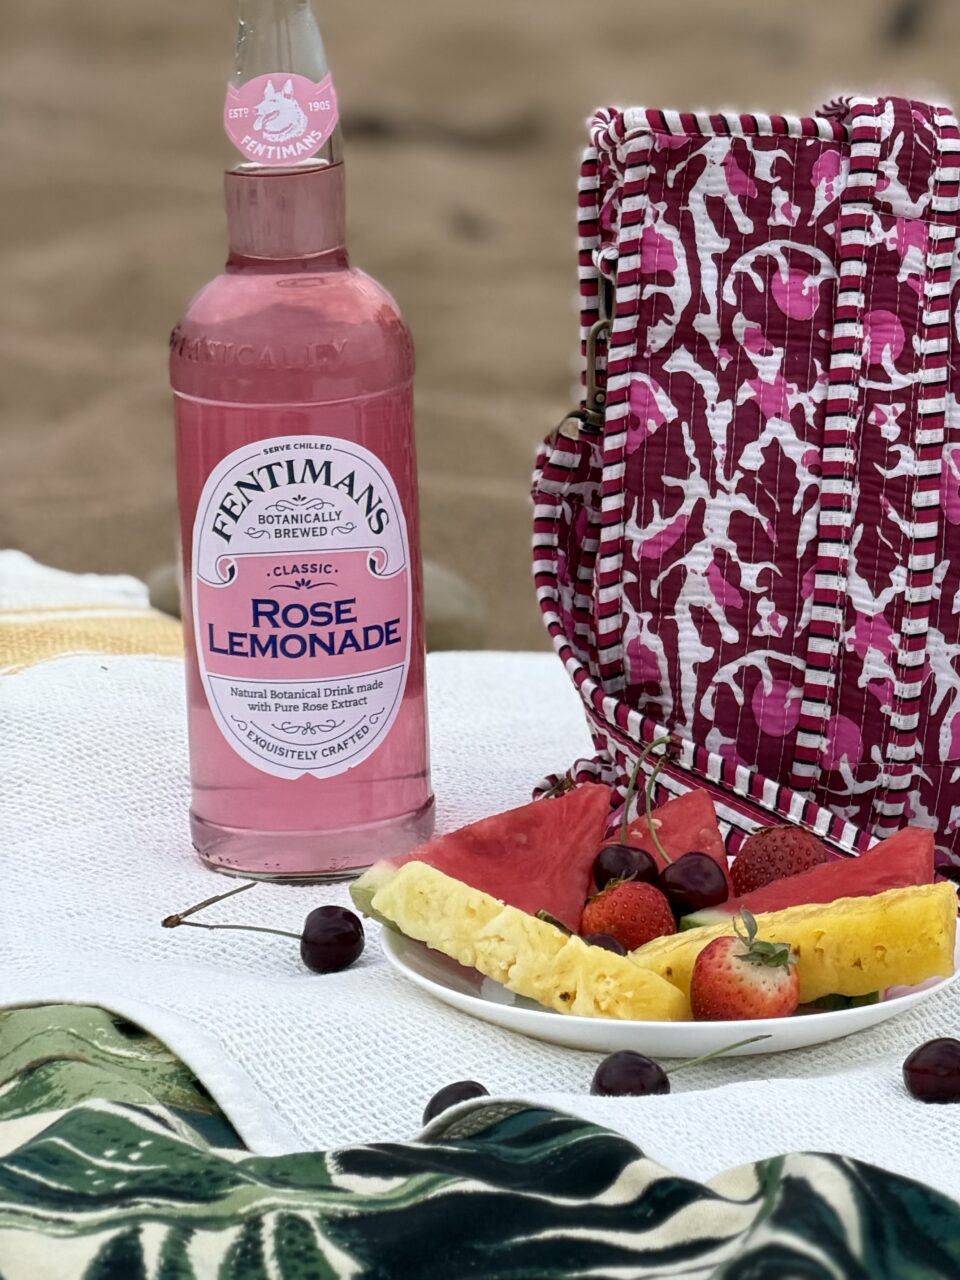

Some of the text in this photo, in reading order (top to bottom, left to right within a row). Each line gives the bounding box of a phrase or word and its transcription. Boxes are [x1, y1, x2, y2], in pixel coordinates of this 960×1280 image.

[308, 100, 331, 112] 1905
[240, 130, 323, 160] FENTIMANS
[263, 442, 333, 456] SERVE CHILLED
[211, 458, 390, 544] FENTIMANS
[257, 510, 343, 525] BOTANICALLY
[274, 526, 328, 539] BREWED
[272, 563, 333, 577] CLASSIC
[251, 597, 358, 629] ROSE
[207, 617, 402, 659] LEMONADE
[230, 680, 384, 700] Natural Botanical Drink made
[247, 696, 368, 713] with Pure Rose Extract
[246, 725, 370, 761] EXQUISITELY CRAFTED
